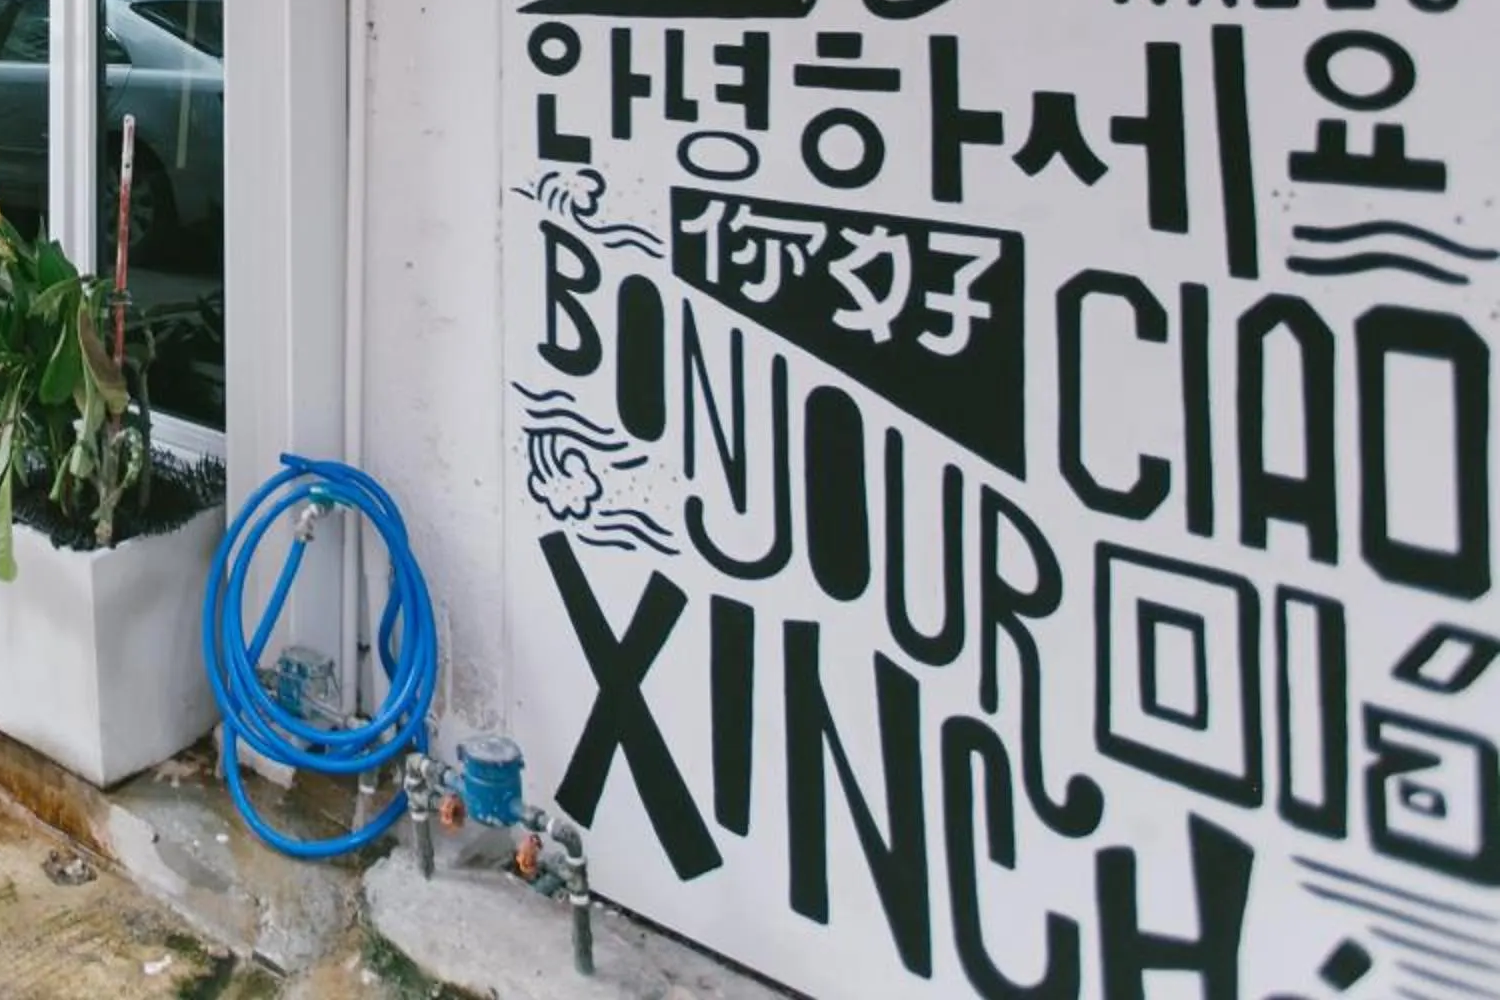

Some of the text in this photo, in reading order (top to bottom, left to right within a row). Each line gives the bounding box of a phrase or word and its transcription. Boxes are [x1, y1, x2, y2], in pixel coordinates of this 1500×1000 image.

[525, 20, 1449, 281] 안녕하세요
[681, 199, 1002, 355] 你好
[538, 220, 1106, 838] BONJOUR
[1055, 268, 1491, 600] CIAO
